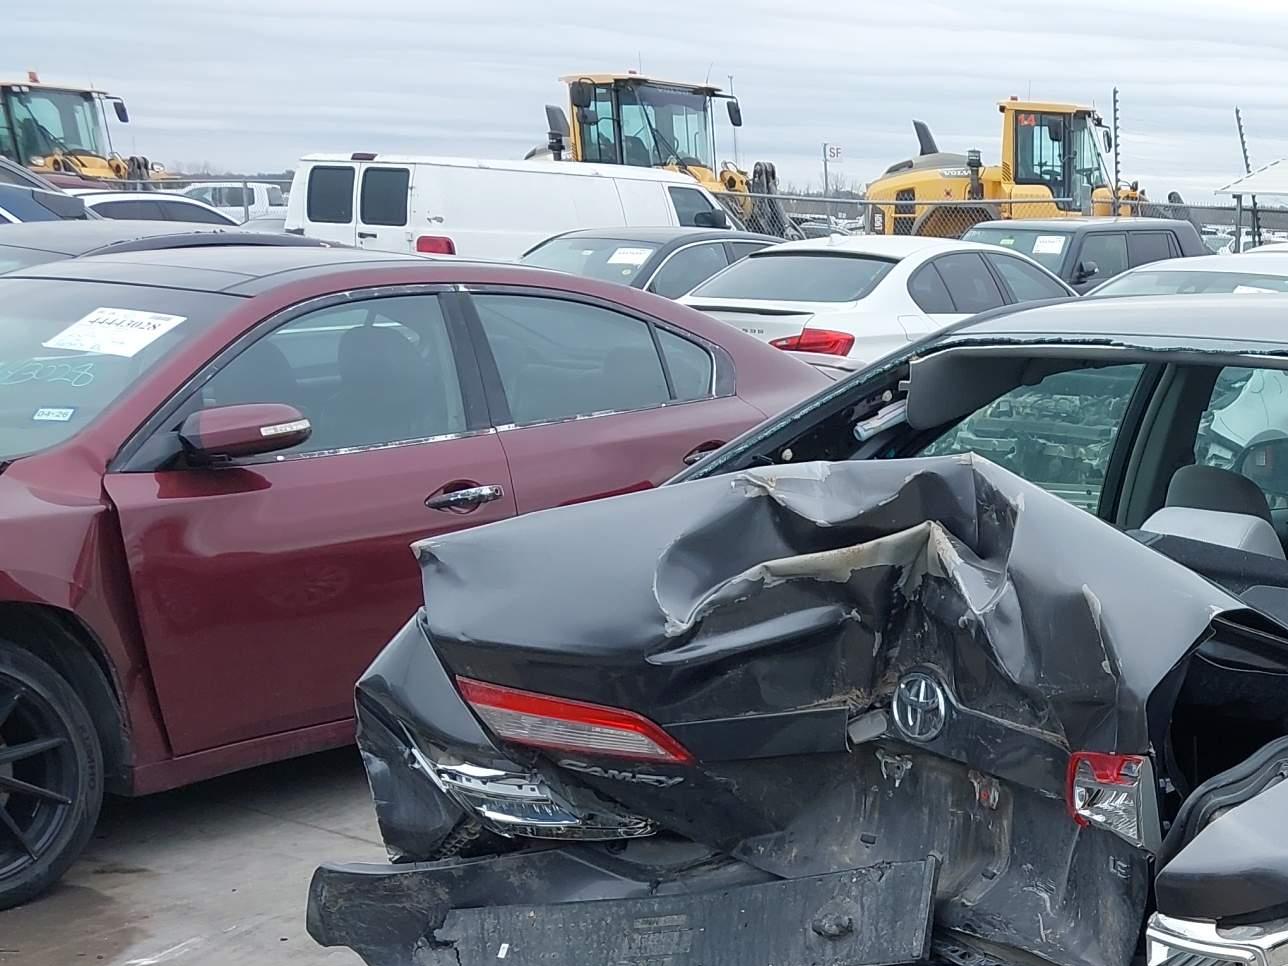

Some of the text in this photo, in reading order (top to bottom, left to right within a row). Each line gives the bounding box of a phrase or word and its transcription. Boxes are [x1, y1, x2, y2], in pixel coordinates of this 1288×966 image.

[829, 147, 841, 158] SF
[558, 759, 685, 787] CAMRY
[1109, 855, 1131, 879] LE
